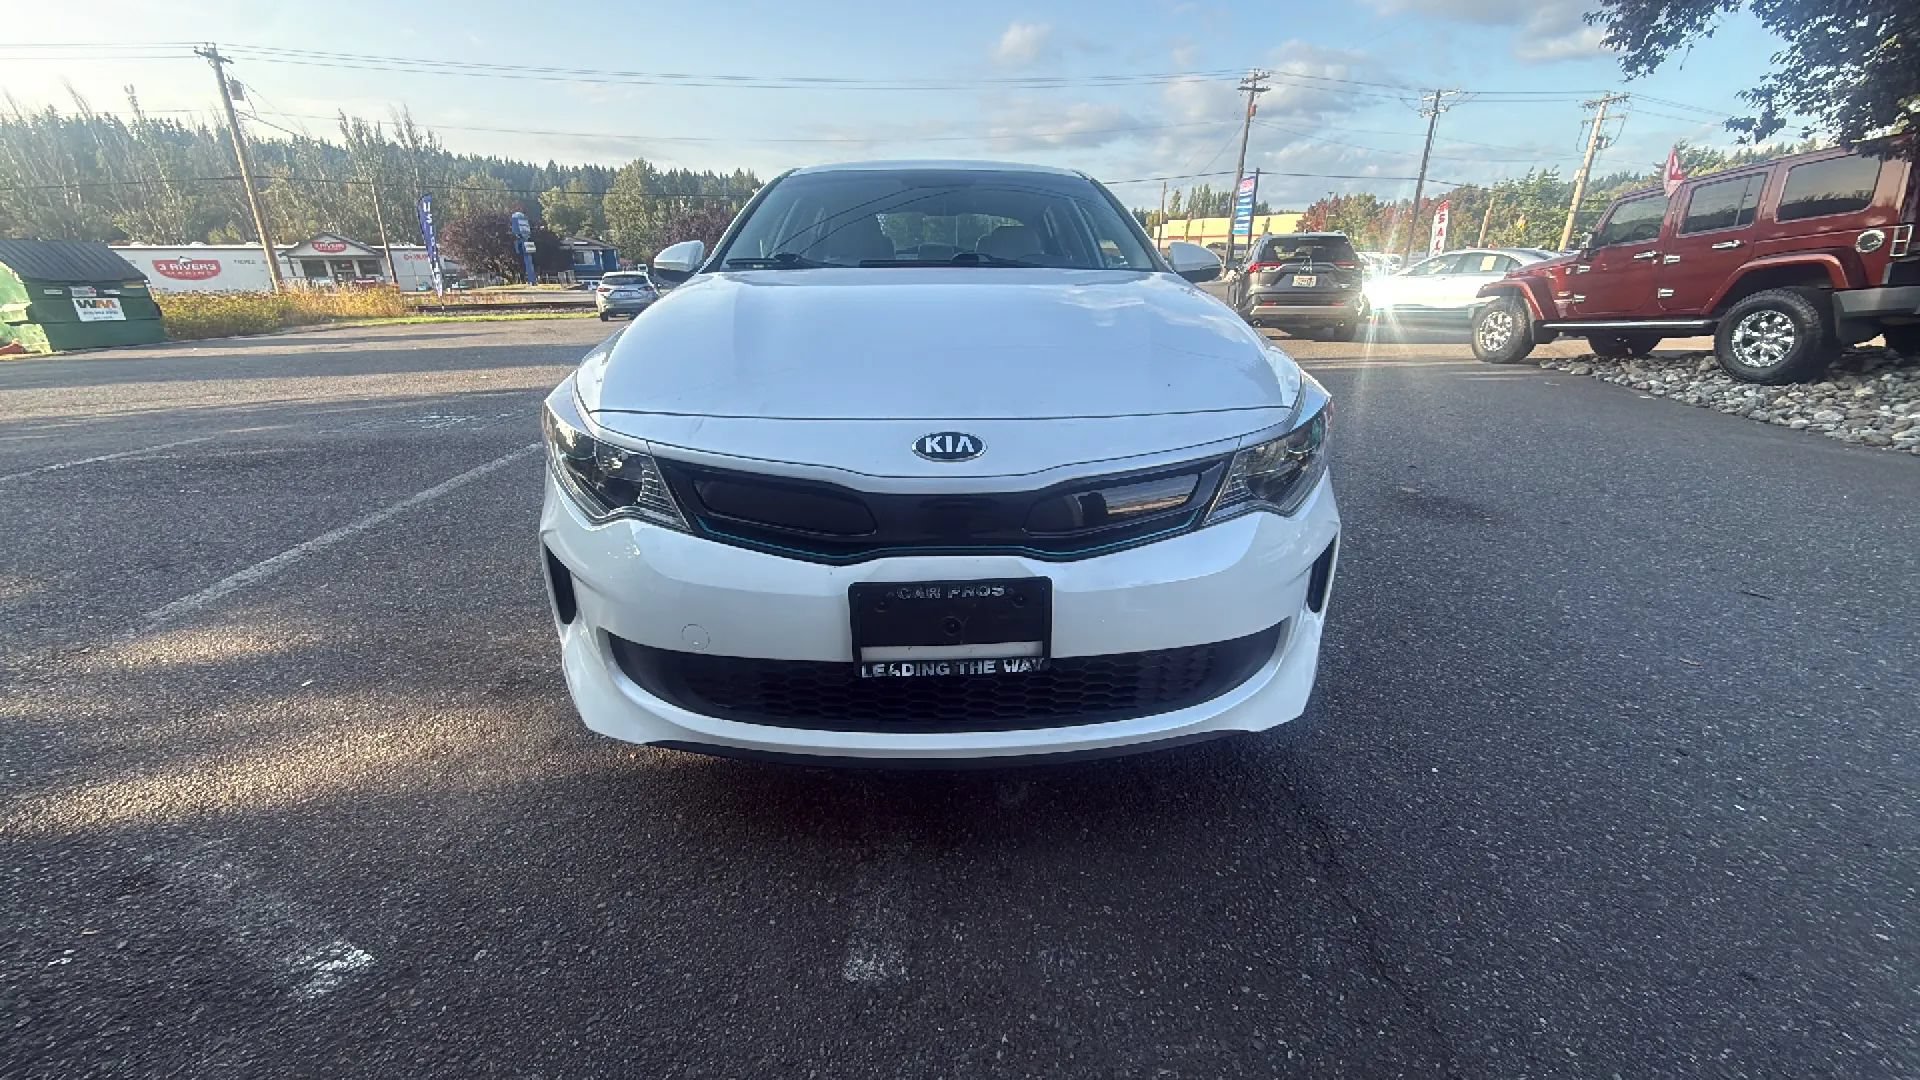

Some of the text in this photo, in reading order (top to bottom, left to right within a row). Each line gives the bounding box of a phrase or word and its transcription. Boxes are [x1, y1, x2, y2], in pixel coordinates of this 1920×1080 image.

[159, 263, 217, 271] 3 RIVERS
[76, 299, 117, 309] WM
[925, 435, 975, 453] KIA
[897, 585, 1005, 599] CAR PROS
[861, 657, 1044, 678] LEADING THE WAY
